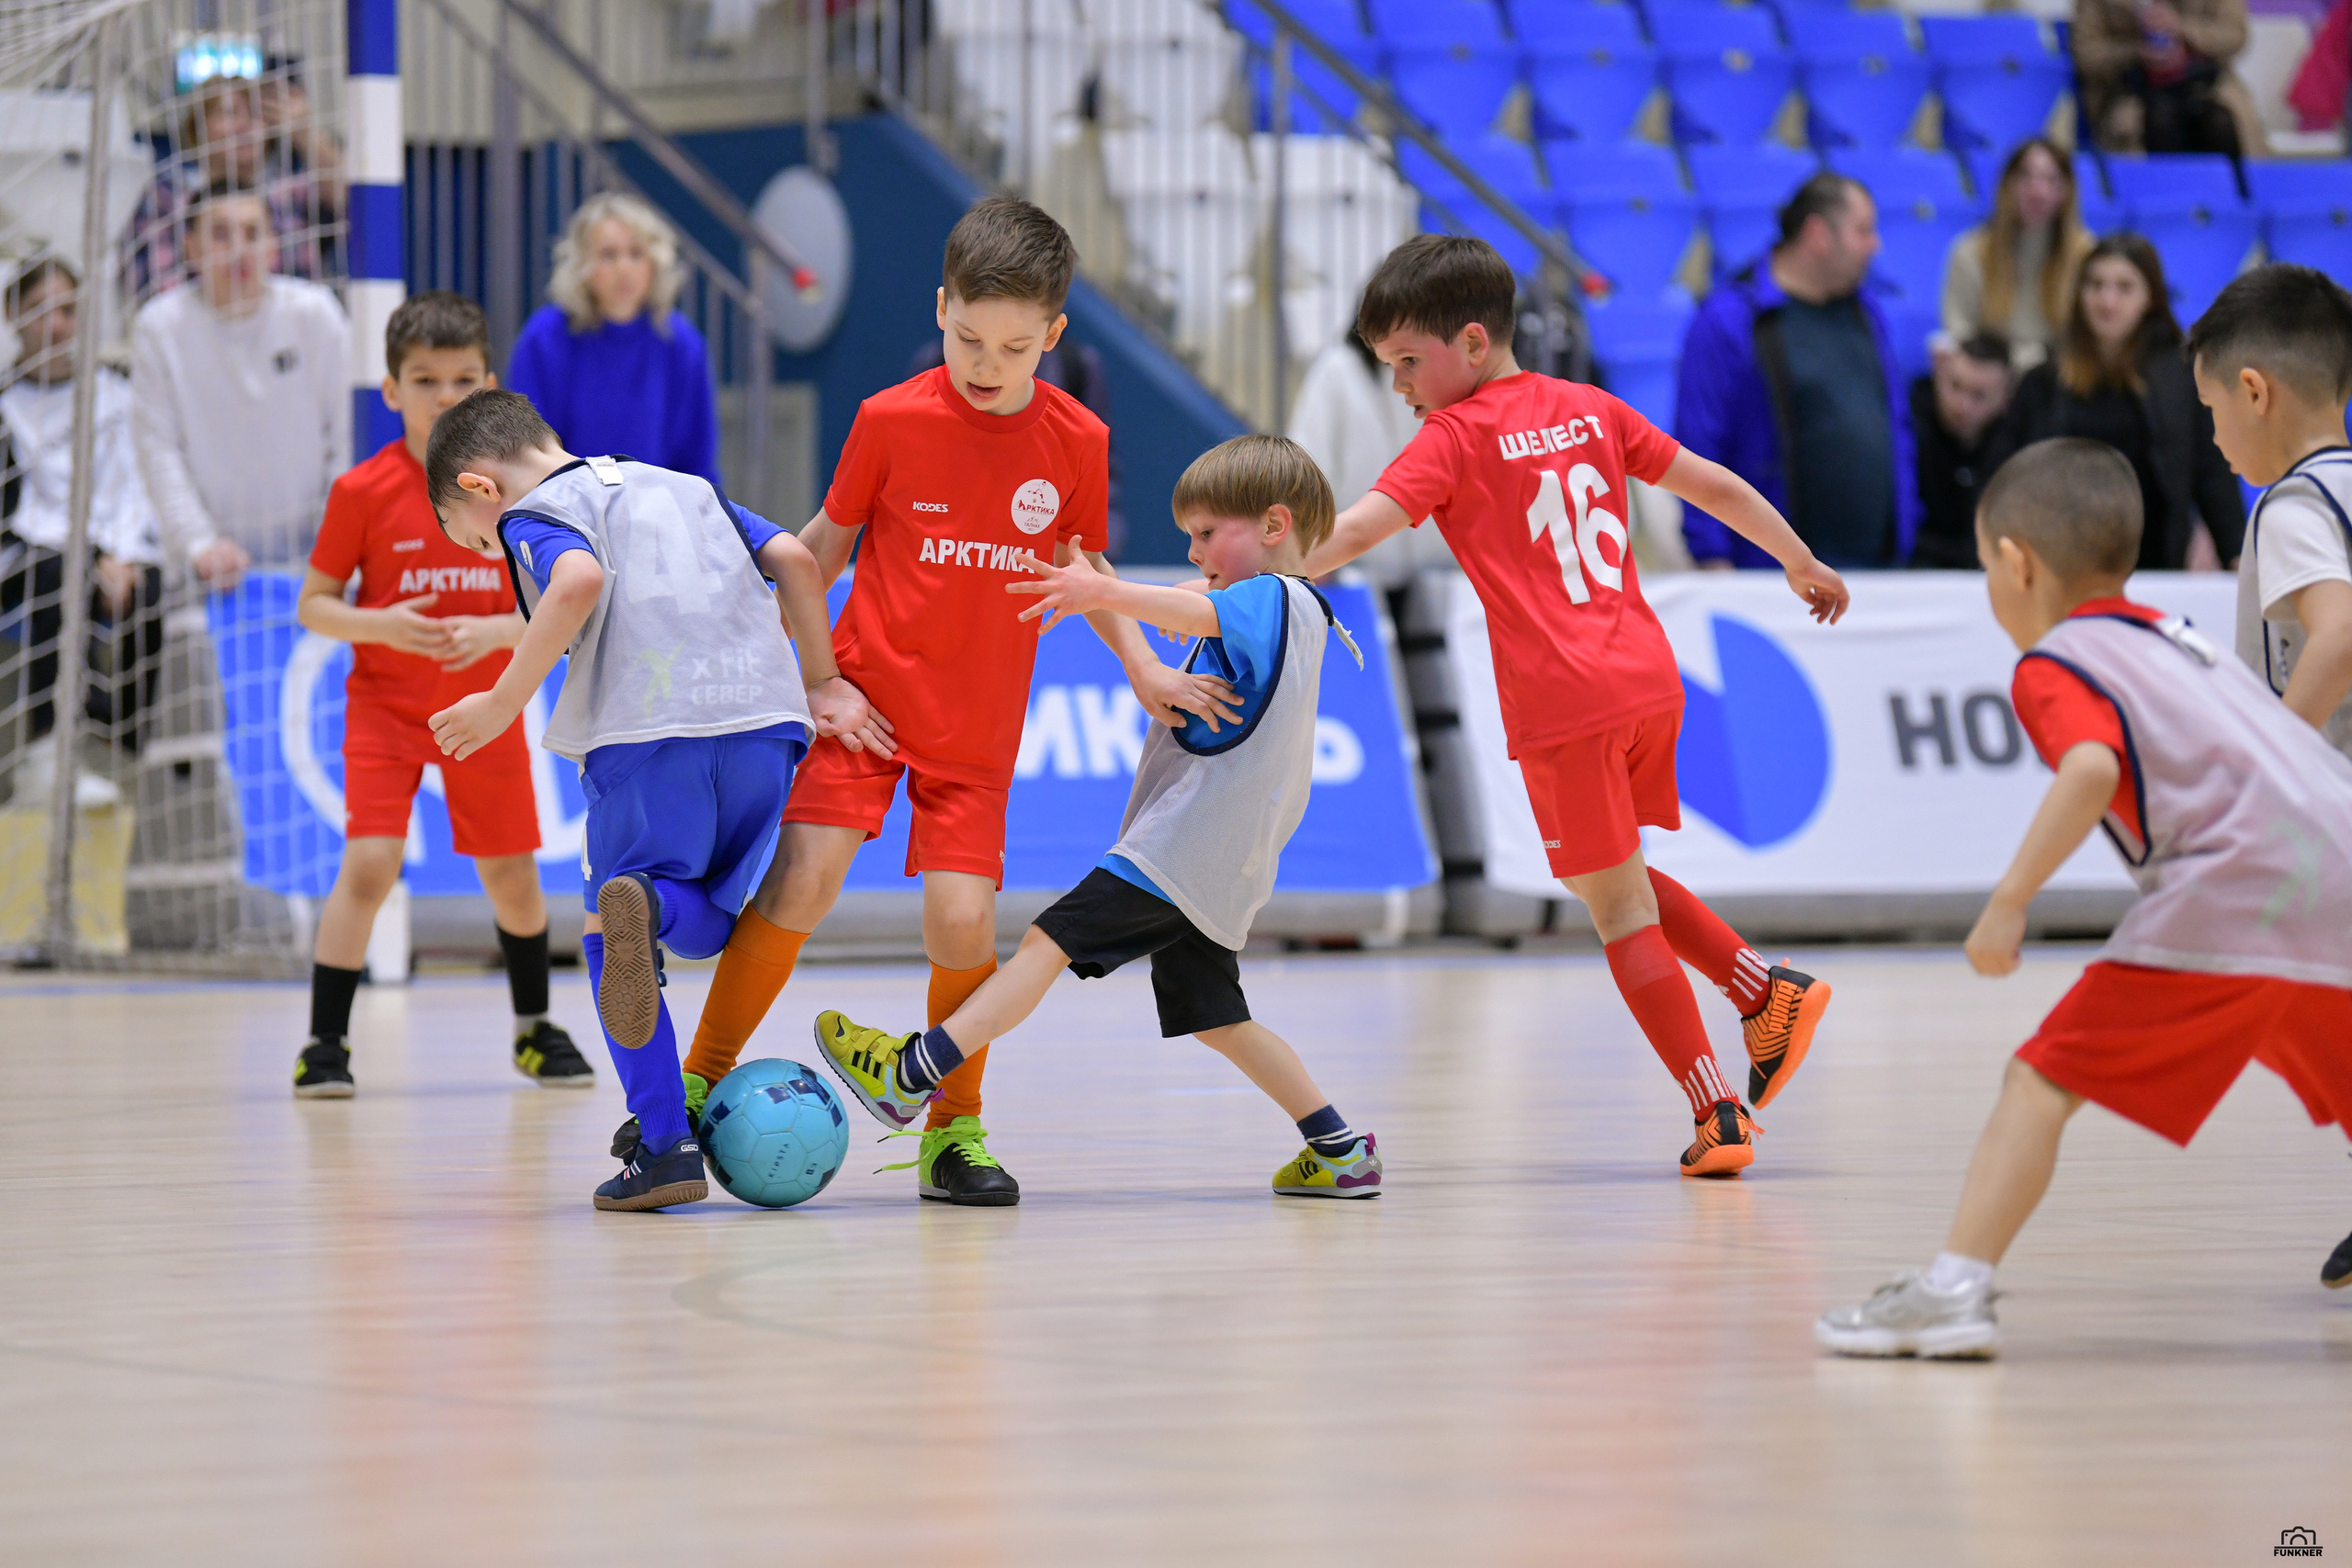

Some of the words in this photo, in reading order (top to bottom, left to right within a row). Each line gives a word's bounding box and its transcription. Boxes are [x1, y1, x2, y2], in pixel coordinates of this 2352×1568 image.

[912, 501, 949, 513] KODES
[1015, 499, 1055, 515] АРКТИКА
[919, 537, 1036, 575] АРКТИКА
[1526, 462, 1628, 605] 16
[1889, 692, 2022, 767] НО
[1768, 979, 1799, 1034] PUMA
